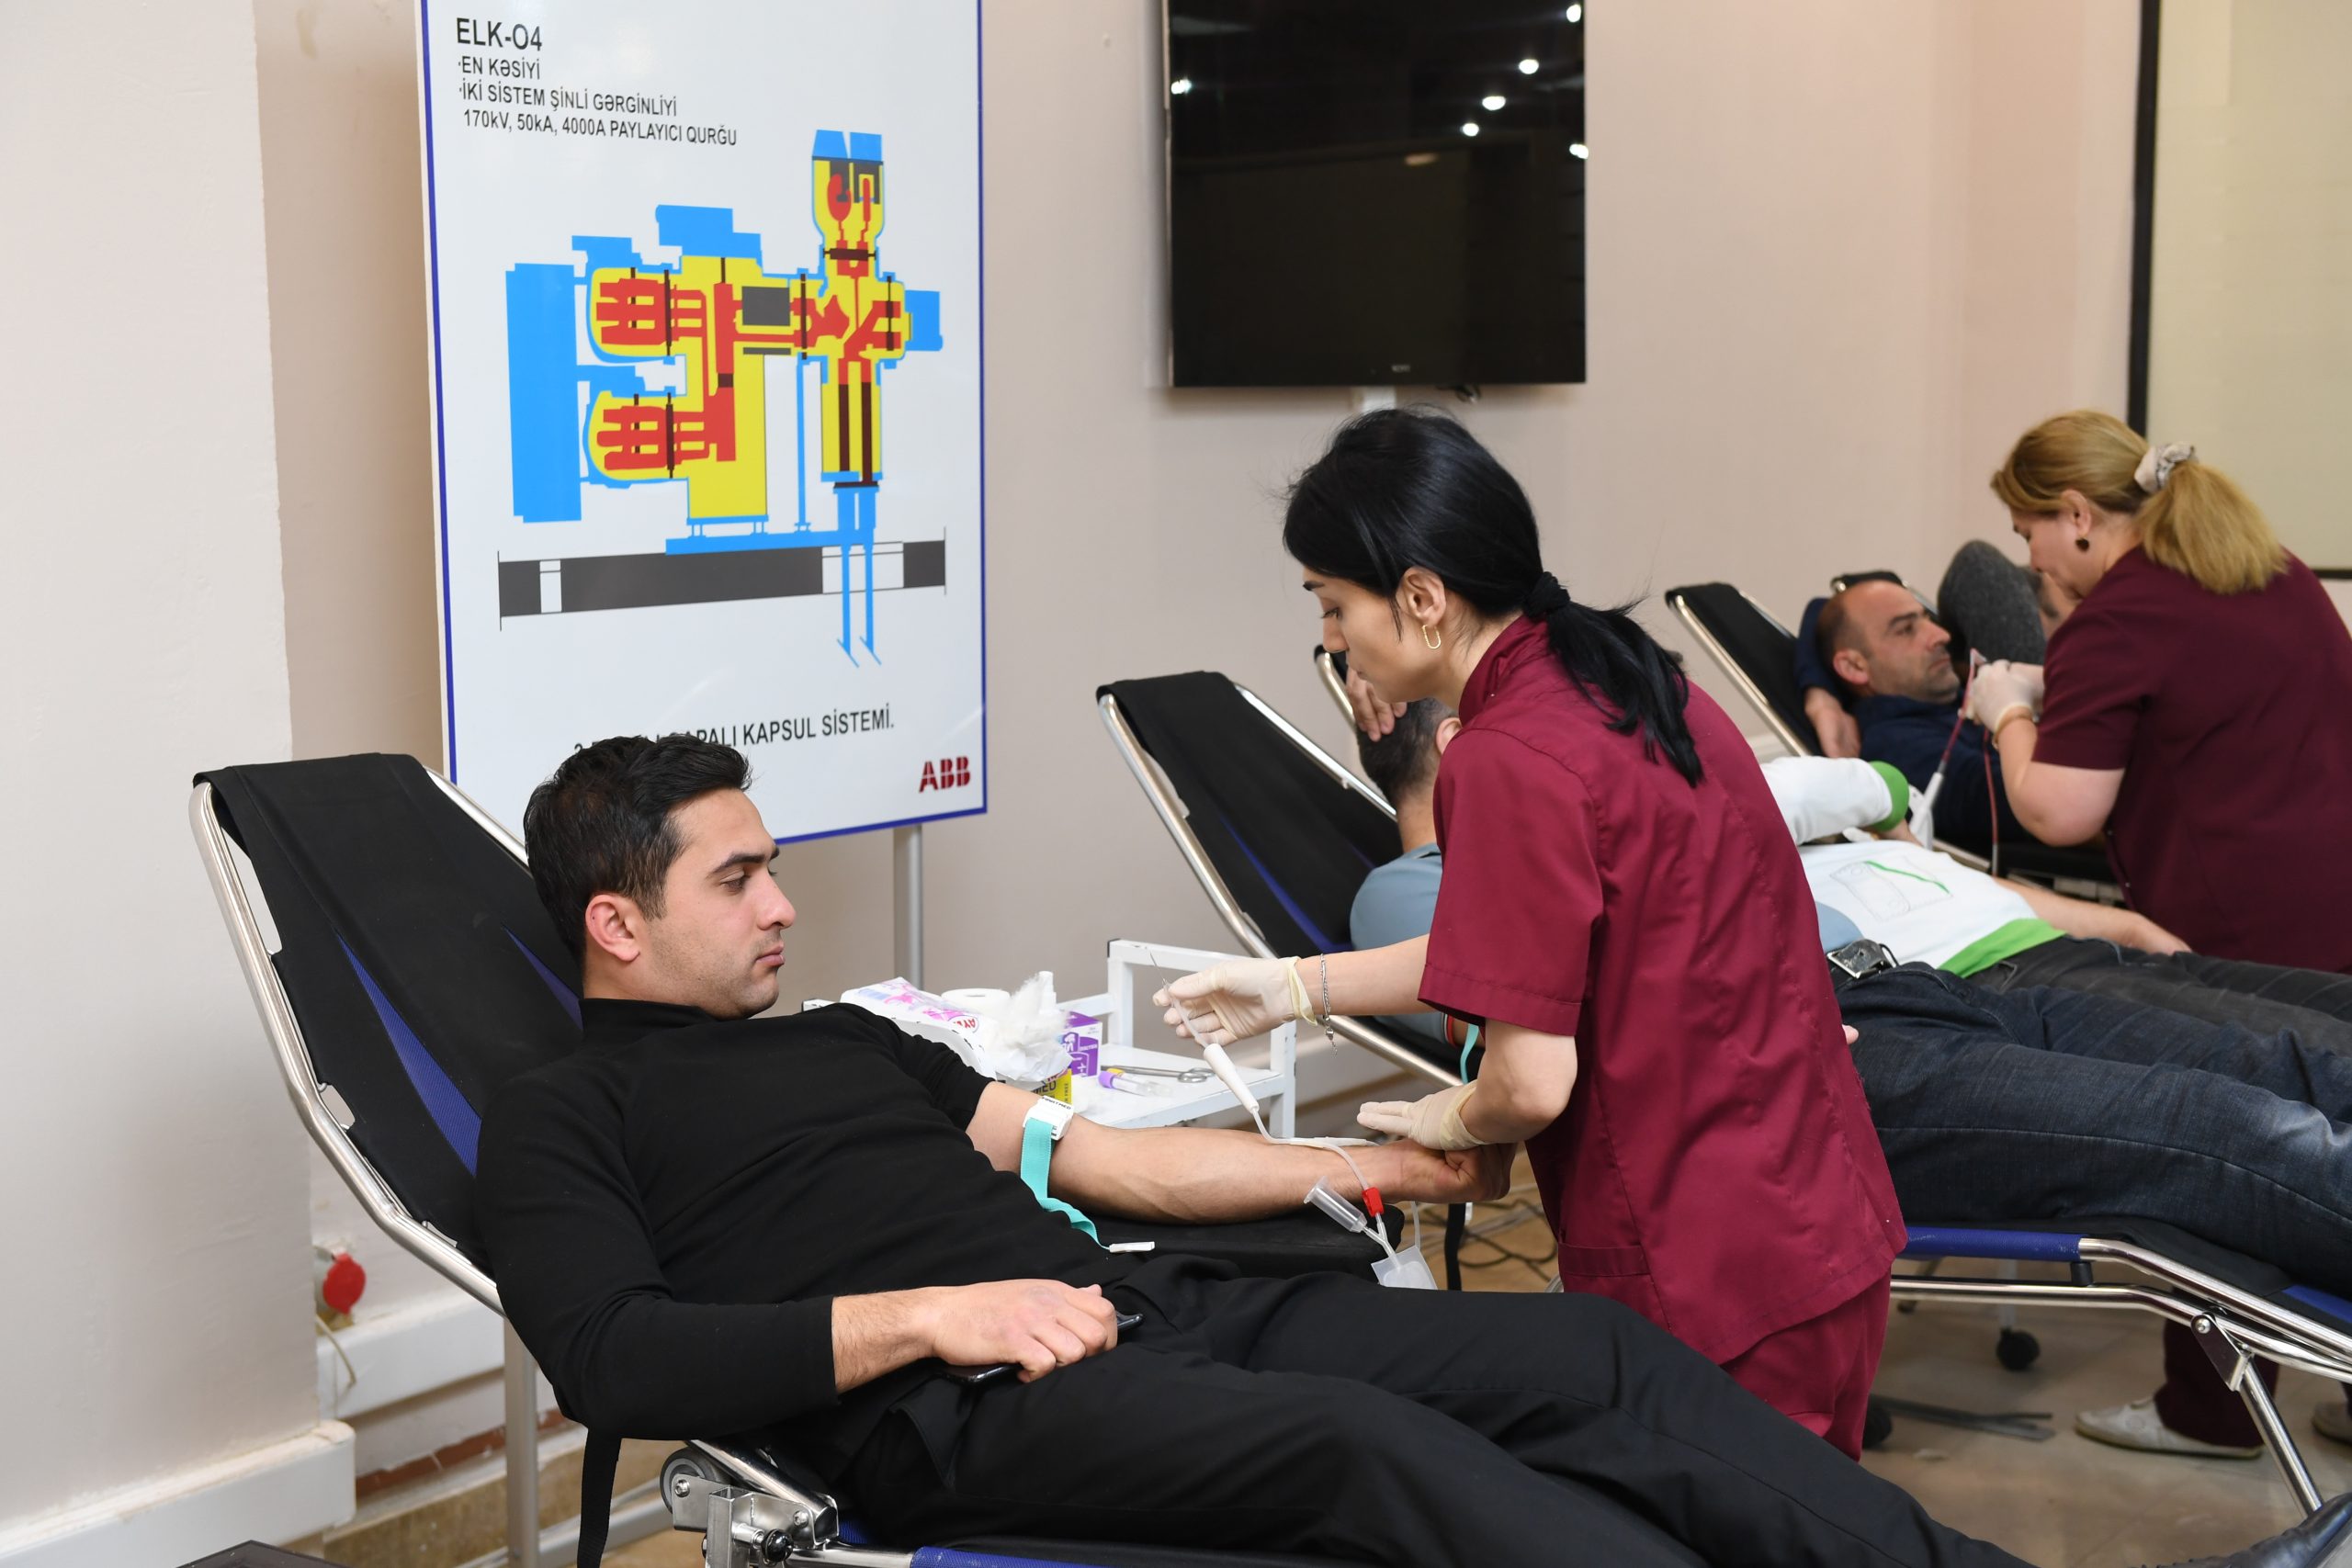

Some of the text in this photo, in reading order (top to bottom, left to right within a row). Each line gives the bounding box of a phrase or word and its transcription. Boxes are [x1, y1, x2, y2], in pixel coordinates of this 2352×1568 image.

[462, 55, 539, 80] EN KƏSİYİ
[462, 78, 676, 117] İKİ SİSTEM ŞİNLİ GƏRGİNLİYİ
[464, 109, 737, 146] 170kV, 50kA, 4000A PAYLAYICI QURĞU
[743, 717, 816, 746] KAPSUL
[822, 703, 894, 736] SİSTEMİ.
[919, 756, 970, 793] ABB
